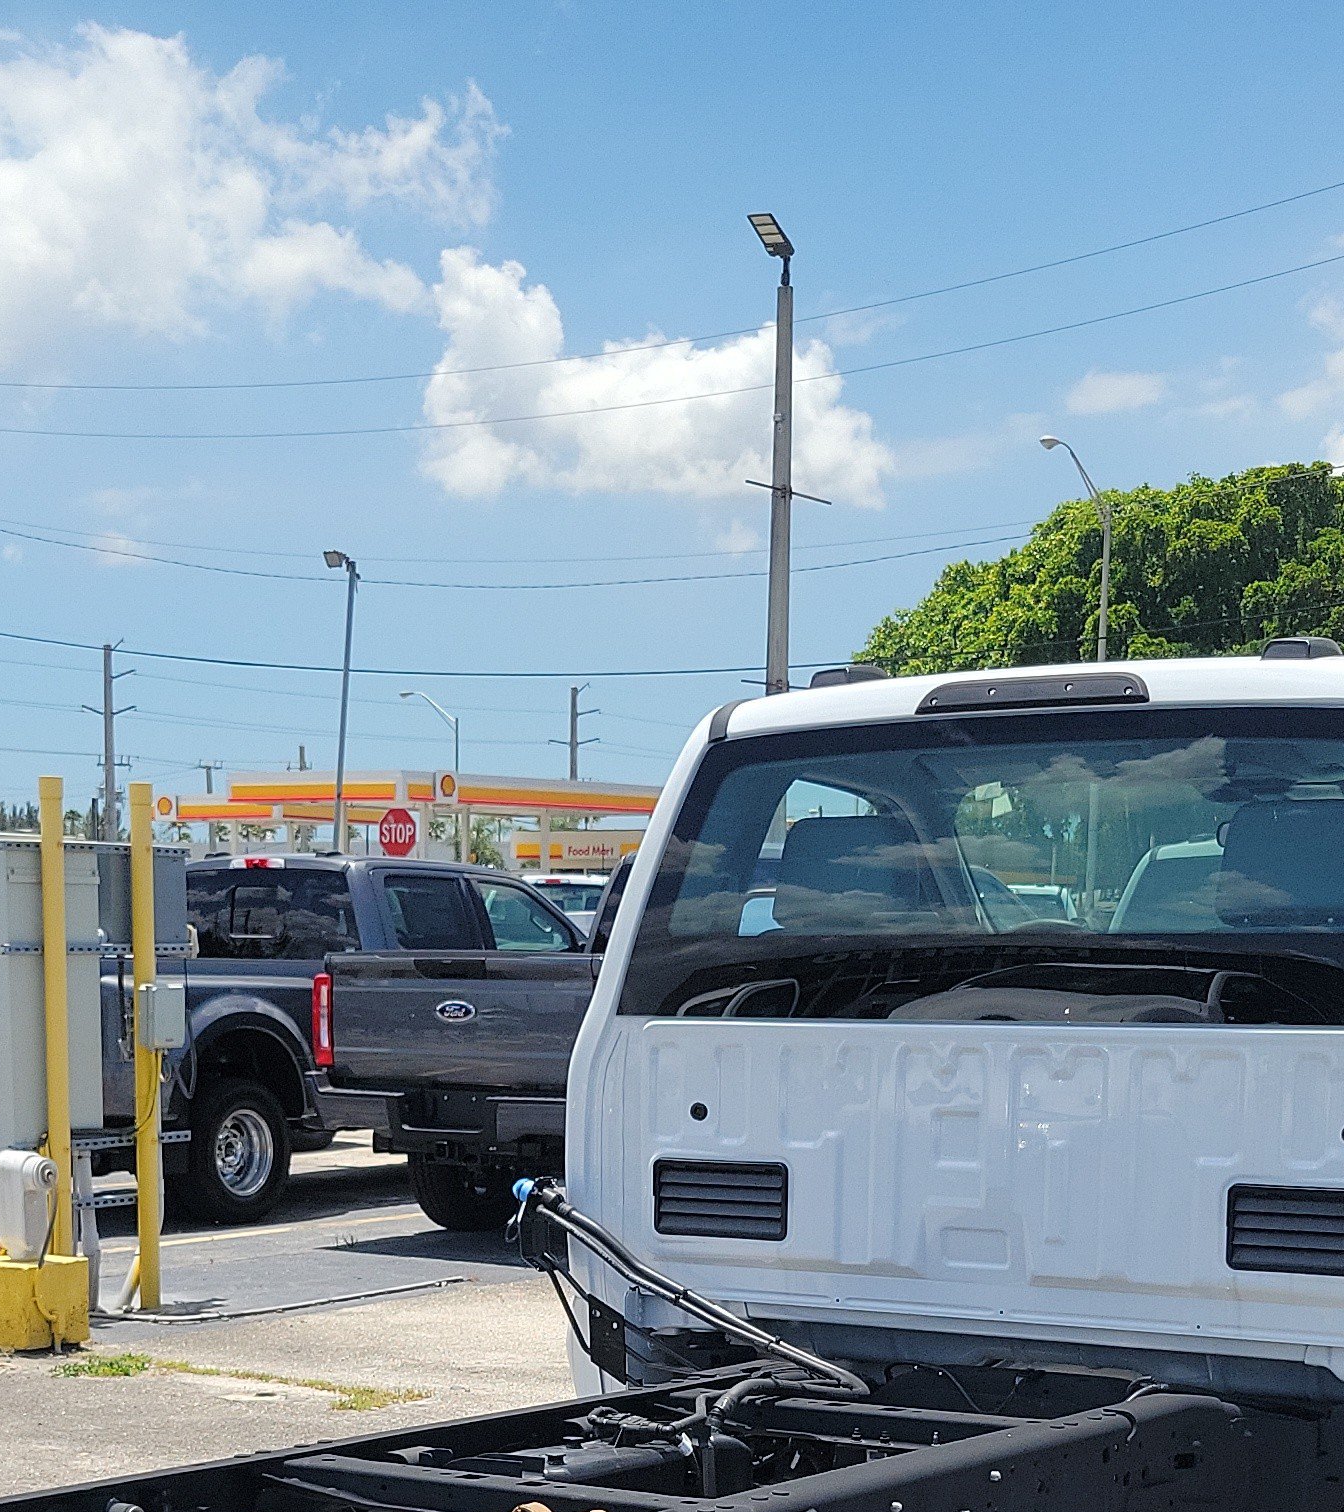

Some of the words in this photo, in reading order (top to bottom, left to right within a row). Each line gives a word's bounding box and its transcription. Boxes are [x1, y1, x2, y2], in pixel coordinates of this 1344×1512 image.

[381, 823, 414, 844] STOP
[567, 845, 590, 857] Food
[592, 845, 614, 857] Mart
